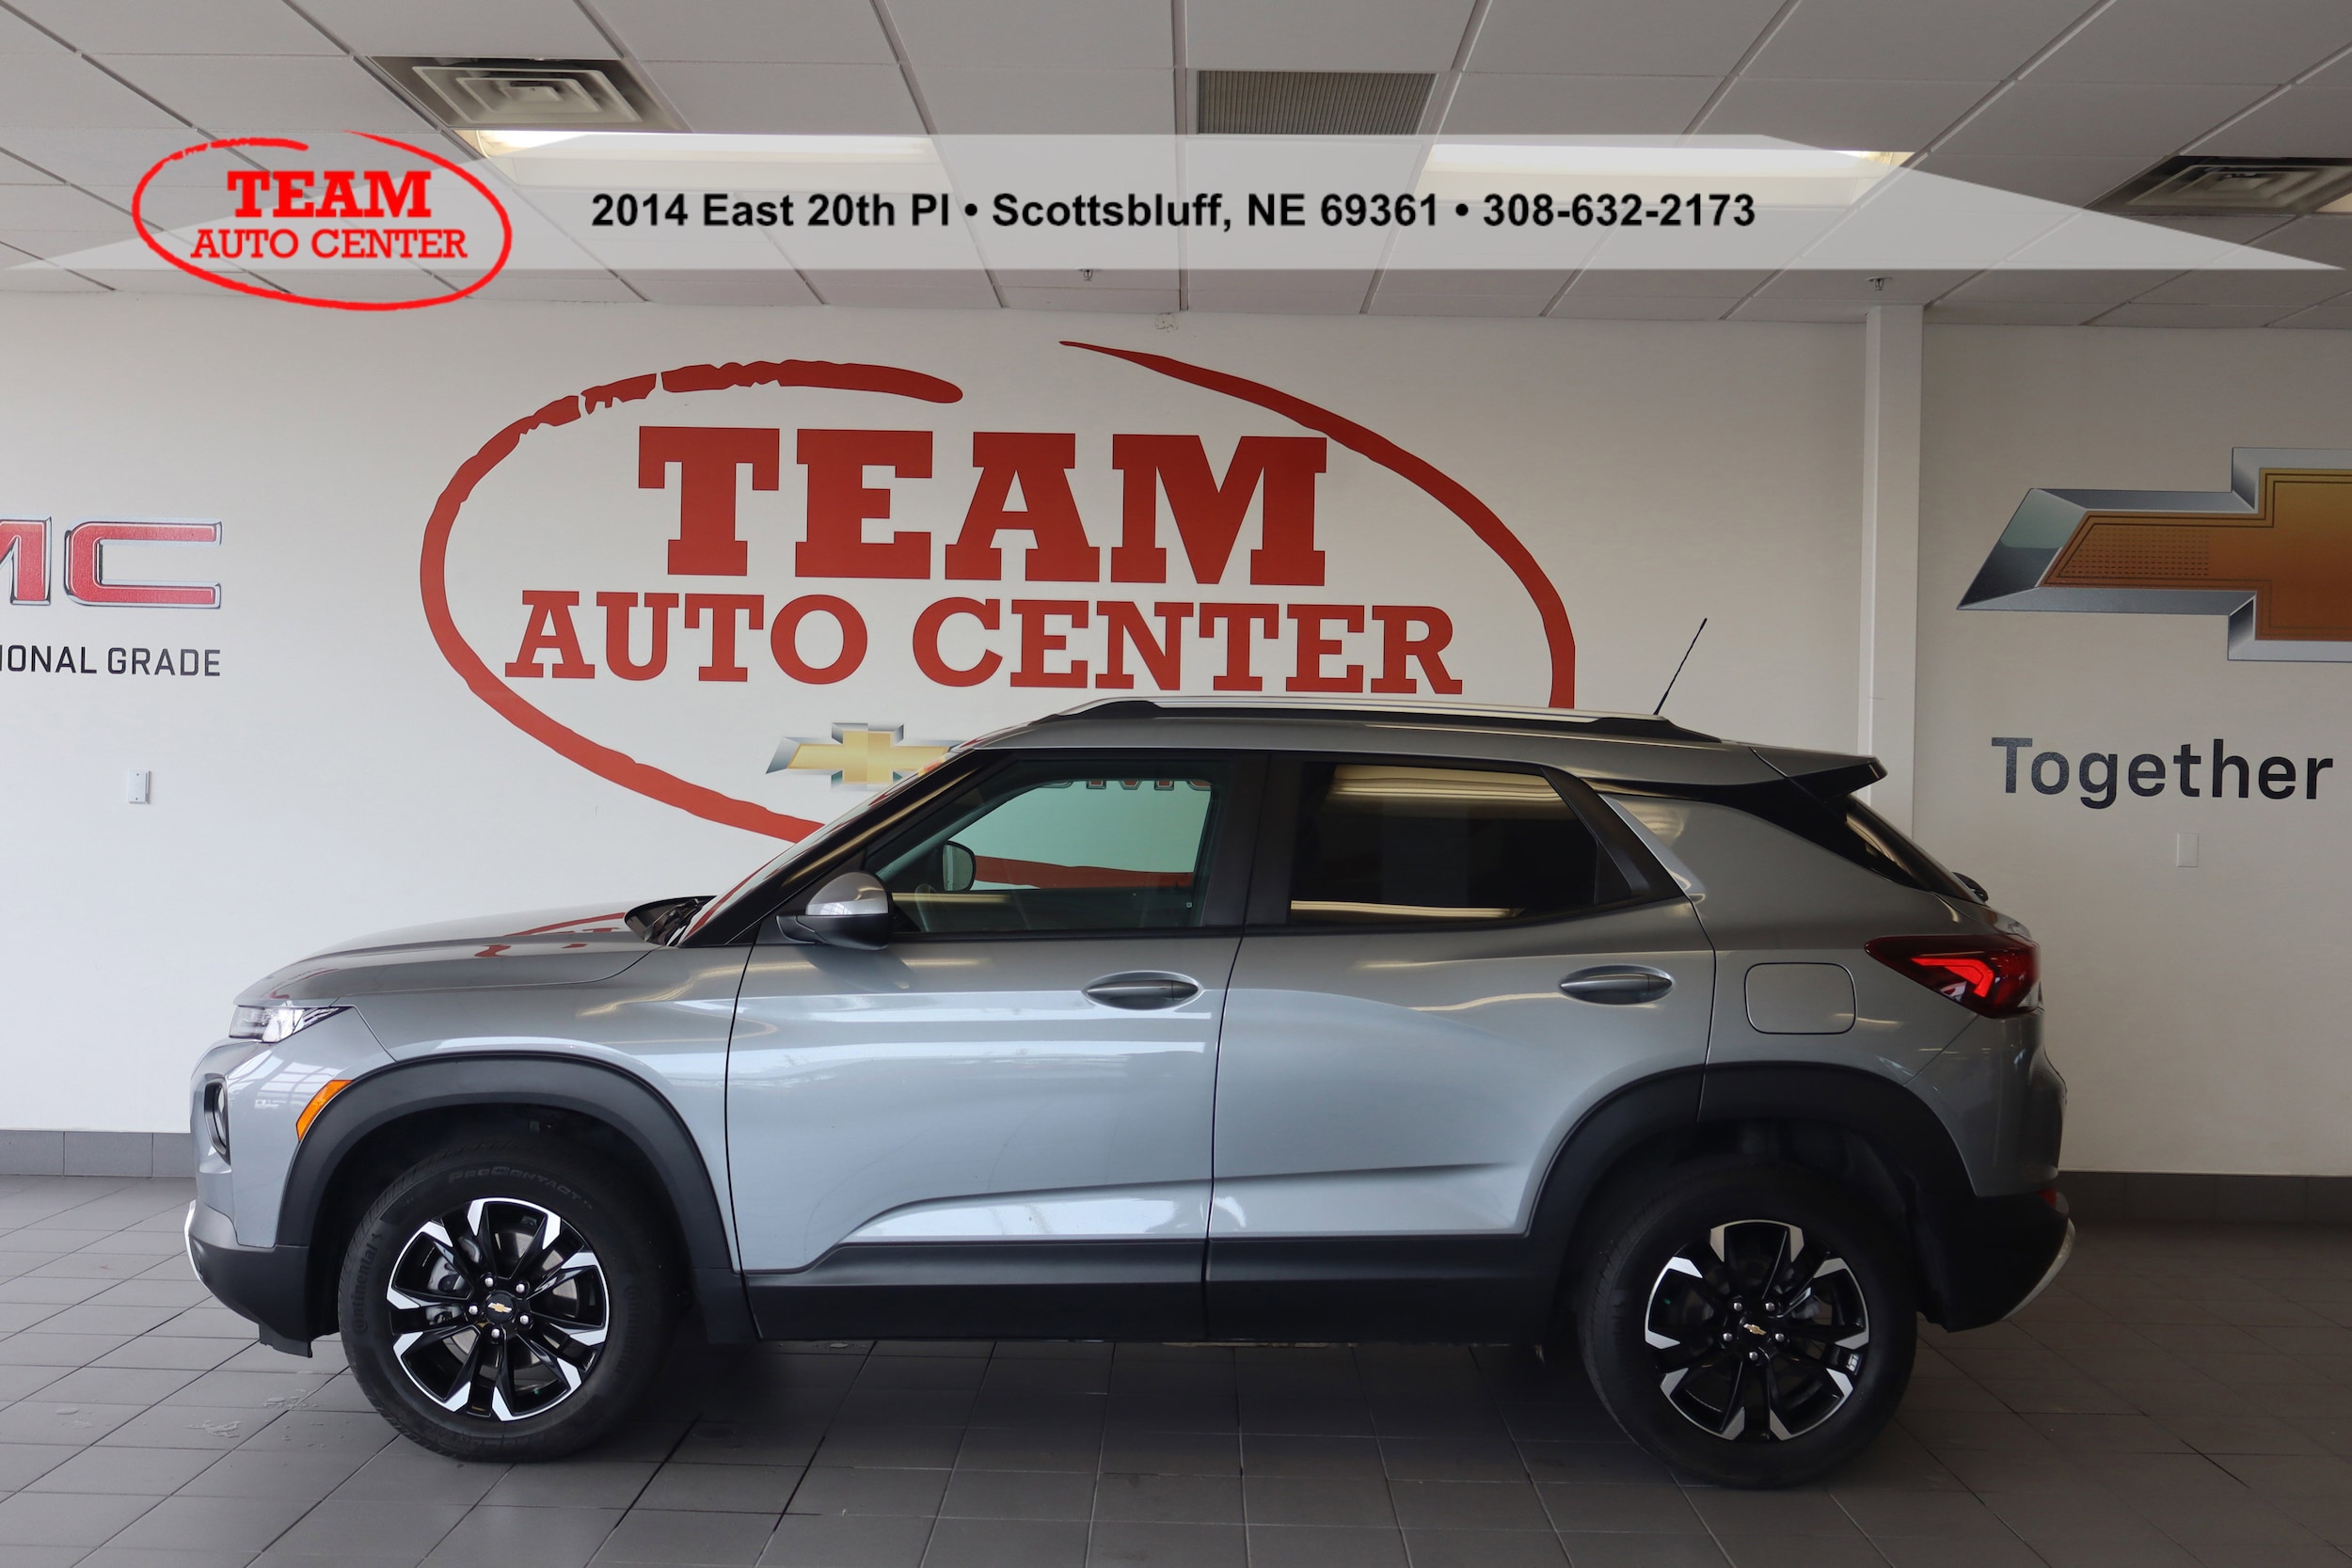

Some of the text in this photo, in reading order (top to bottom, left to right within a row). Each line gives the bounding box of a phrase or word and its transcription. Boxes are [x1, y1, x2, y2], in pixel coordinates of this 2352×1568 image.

[639, 426, 1327, 586] TEAM
[107, 647, 220, 676] GRADE
[504, 591, 1463, 695] AUTO CENTER
[1991, 736, 2333, 810] Together
